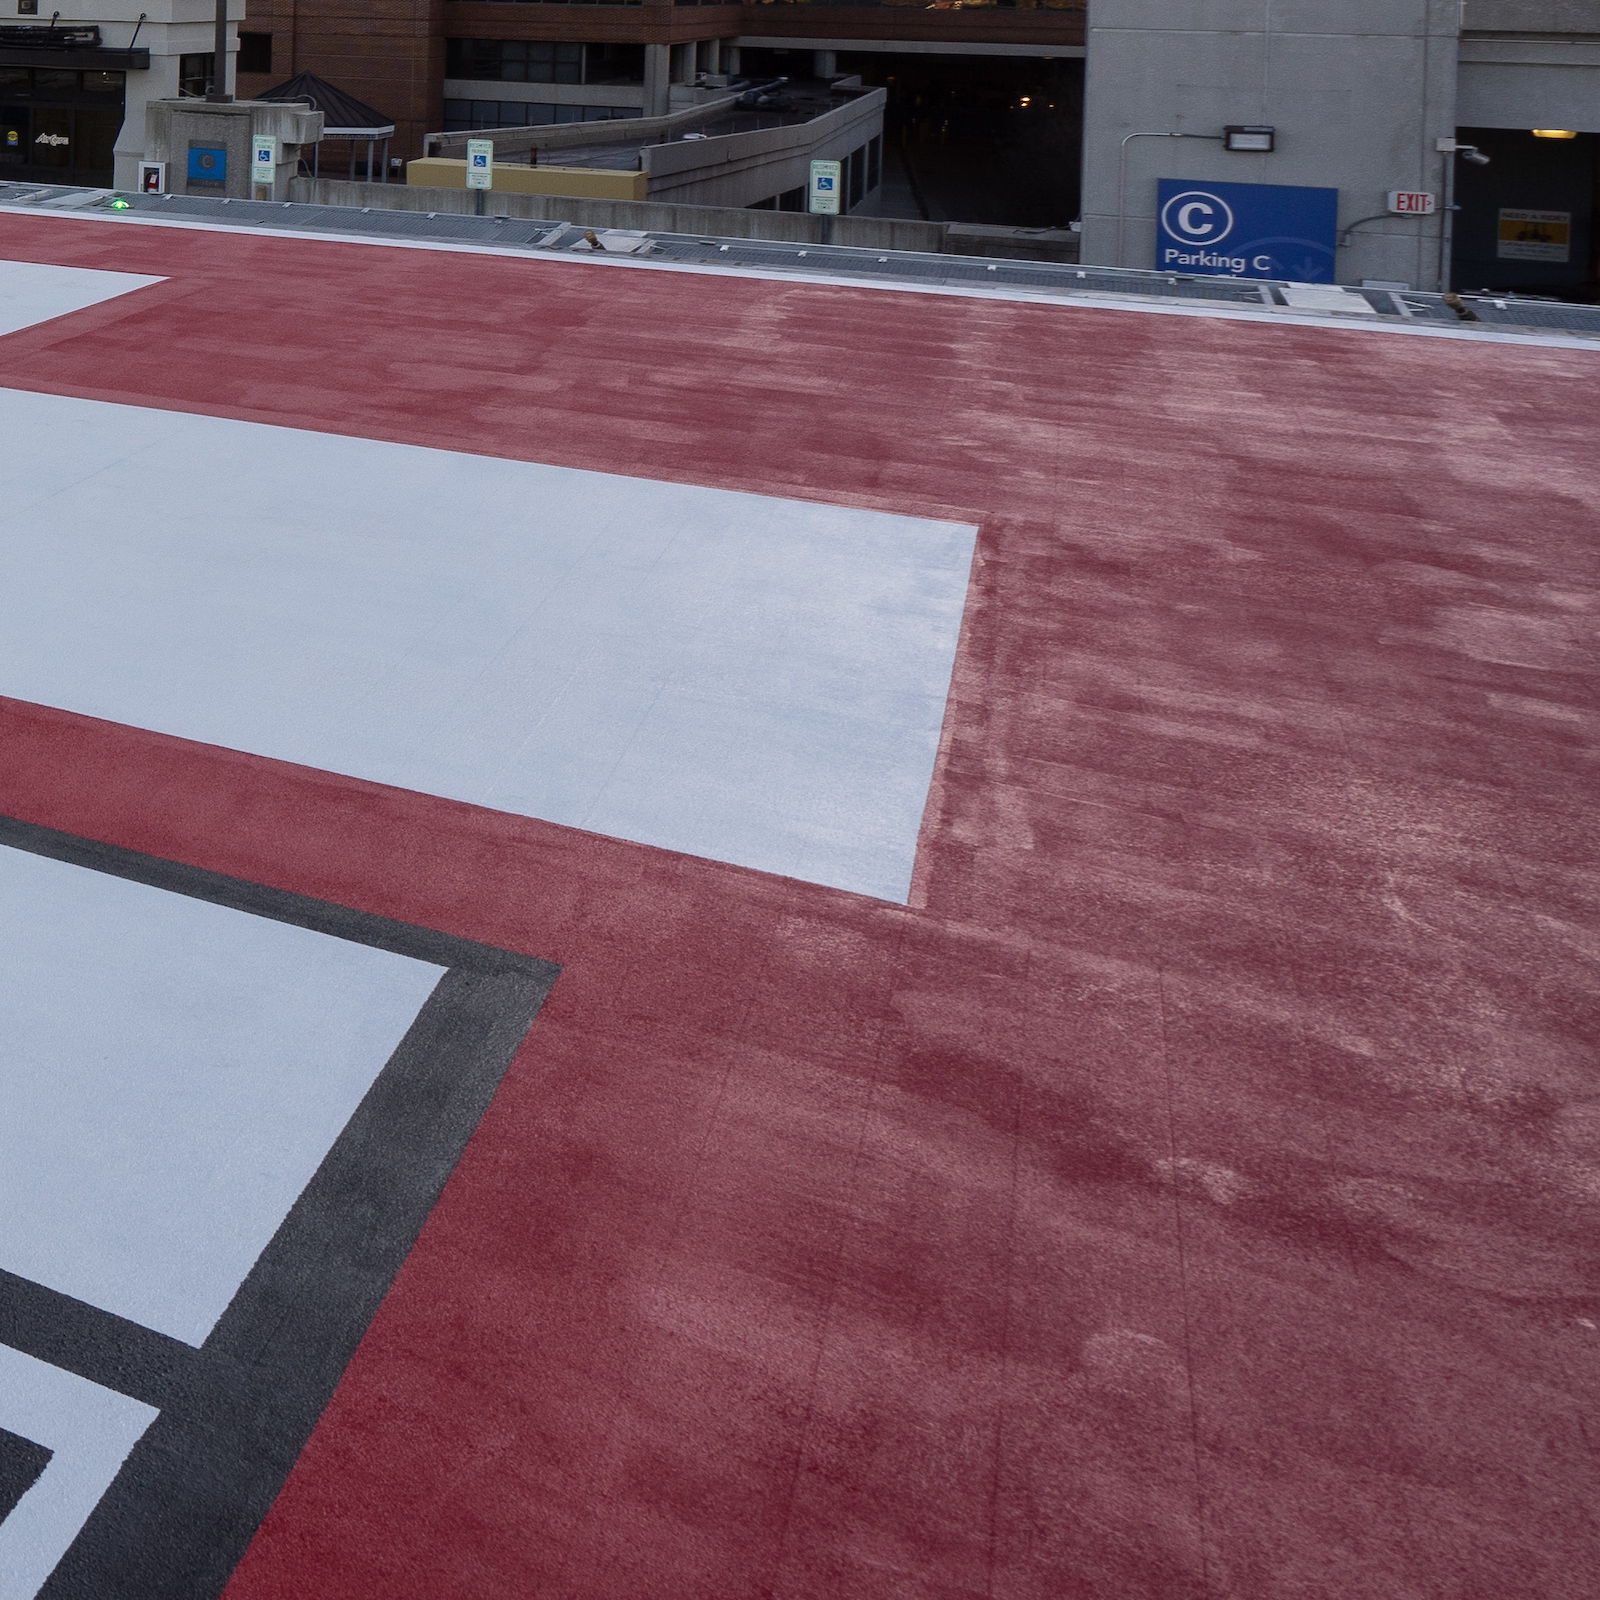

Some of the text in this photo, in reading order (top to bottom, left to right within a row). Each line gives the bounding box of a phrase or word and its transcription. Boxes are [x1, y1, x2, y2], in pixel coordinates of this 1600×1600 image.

[1397, 192, 1429, 212] EXIT
[1177, 202, 1213, 235] C
[1164, 248, 1271, 273] Parking C
